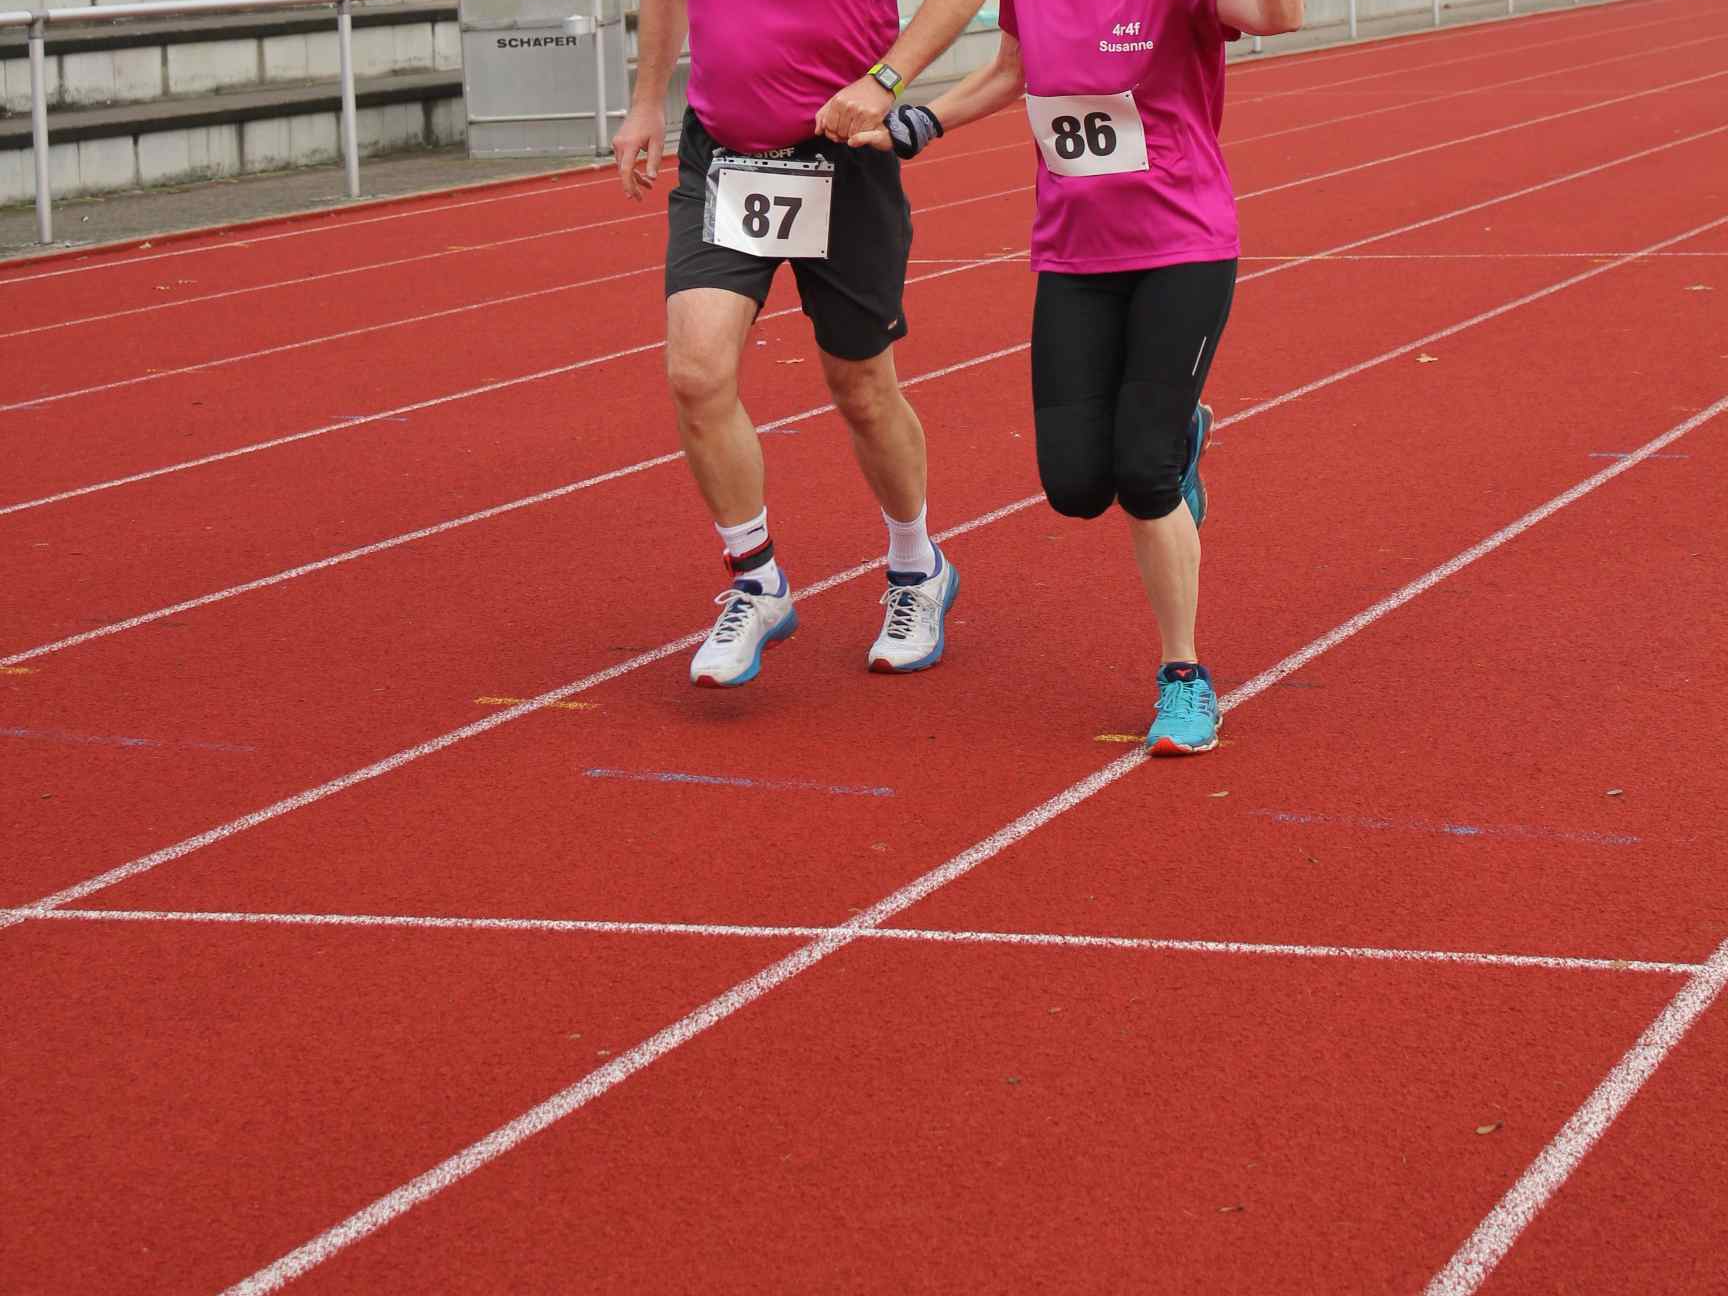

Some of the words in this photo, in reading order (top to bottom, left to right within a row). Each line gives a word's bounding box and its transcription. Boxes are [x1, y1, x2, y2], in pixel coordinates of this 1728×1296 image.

[1112, 22, 1141, 36] 4r4f
[496, 36, 577, 48] SCHAPER
[1099, 40, 1153, 52] Susanne
[1051, 112, 1117, 160] 86
[742, 193, 803, 240] 87
